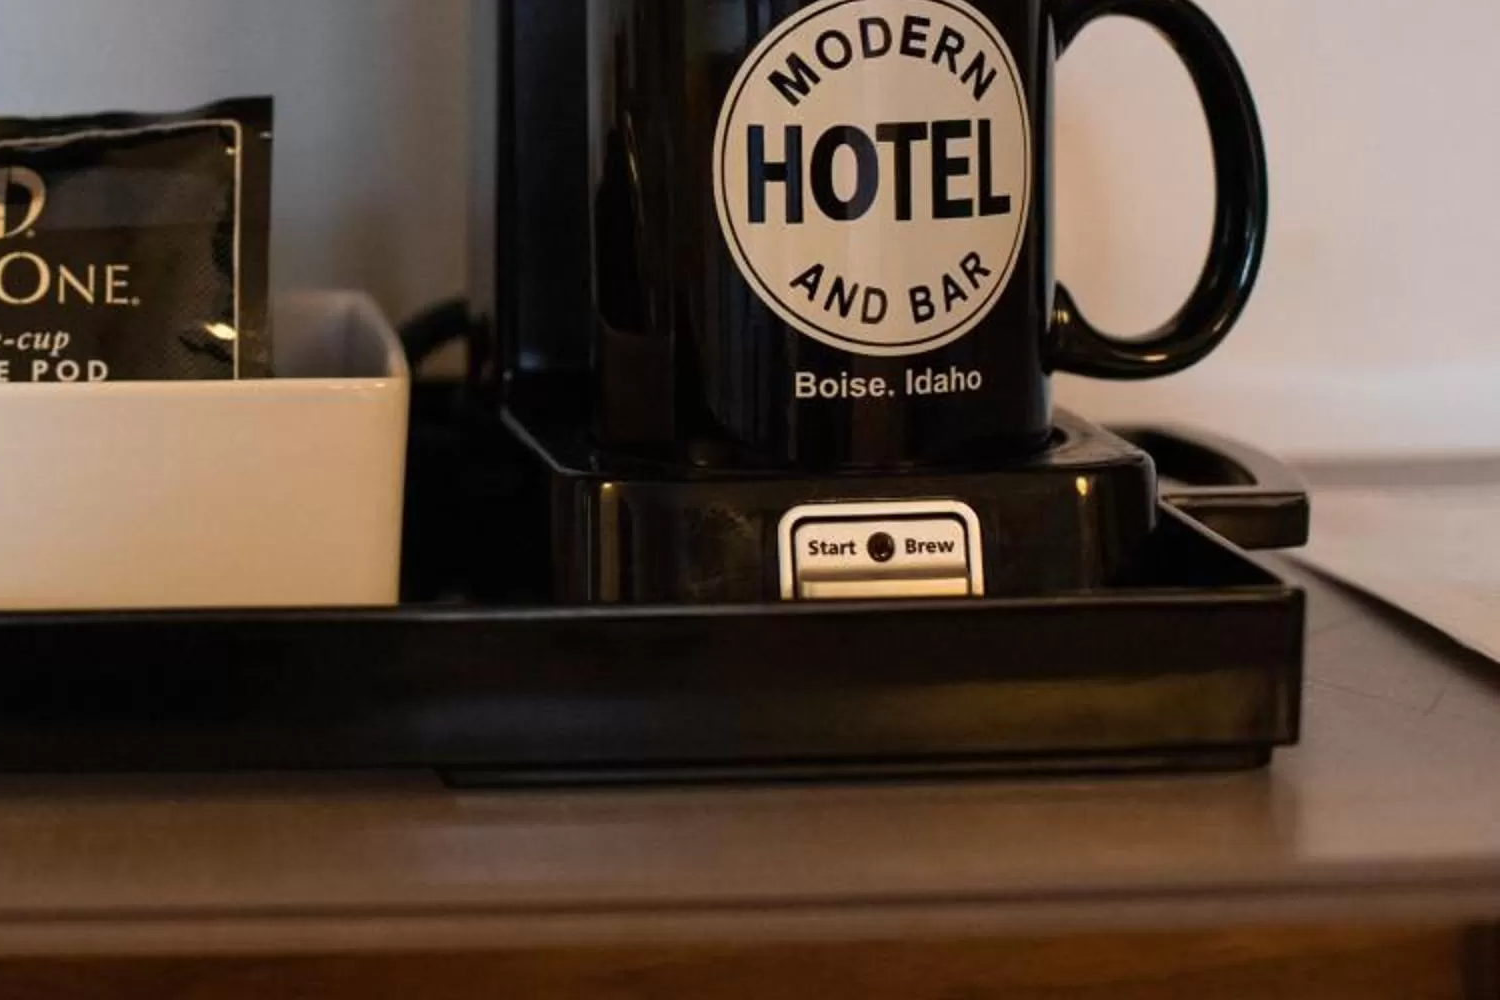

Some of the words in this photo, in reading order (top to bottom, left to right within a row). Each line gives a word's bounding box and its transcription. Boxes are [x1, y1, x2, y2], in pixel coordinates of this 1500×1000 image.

[767, 15, 998, 106] MODERN
[746, 118, 1012, 225] HOTEL
[790, 263, 889, 326] AND
[908, 250, 992, 325] BAR
[31, 359, 109, 382] POD
[905, 365, 983, 396] Idaho
[808, 539, 857, 556] Start
[905, 537, 955, 554] Brew
